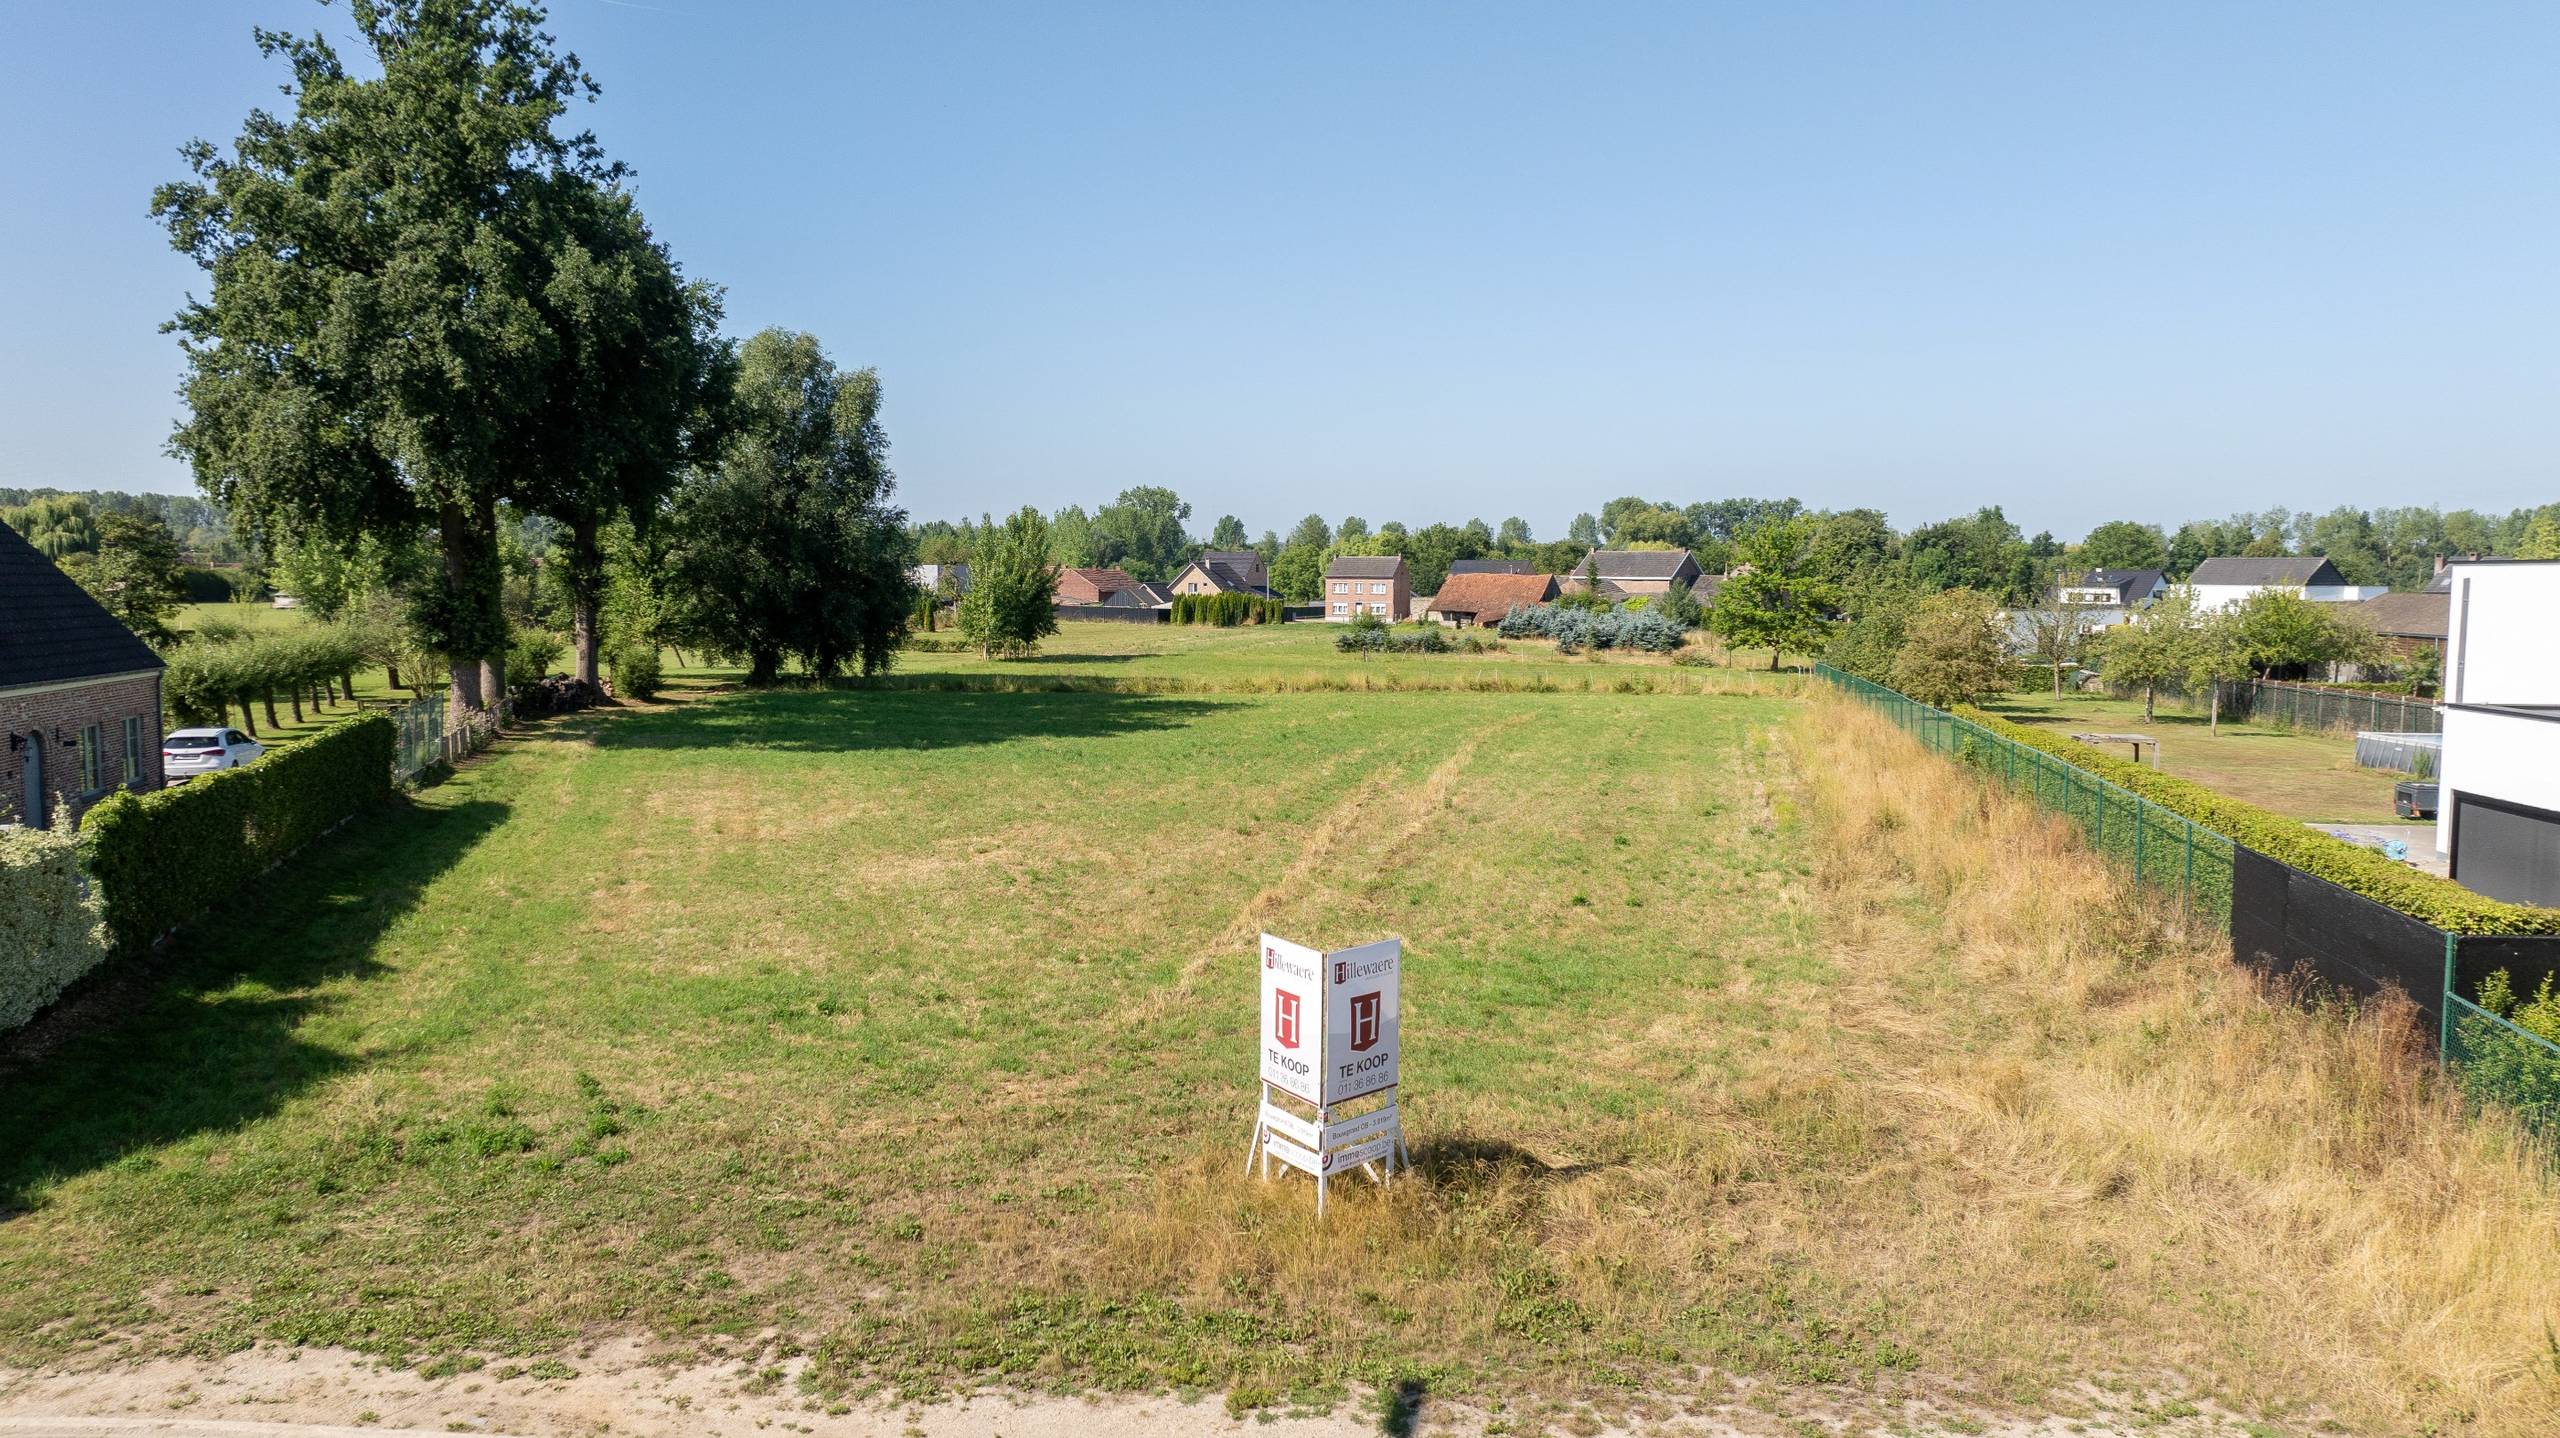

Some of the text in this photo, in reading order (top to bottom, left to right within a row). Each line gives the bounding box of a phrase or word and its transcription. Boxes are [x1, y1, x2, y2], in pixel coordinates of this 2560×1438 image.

[1266, 947, 1314, 981] Hillewaere
[1334, 958, 1394, 984] Hillewaere
[1277, 993, 1298, 1044] H
[1354, 997, 1379, 1046] H
[1268, 1048, 1309, 1076] TE KOOP
[1339, 1052, 1389, 1079] TE KOOP
[1337, 1070, 1389, 1096] 011 36 86 86
